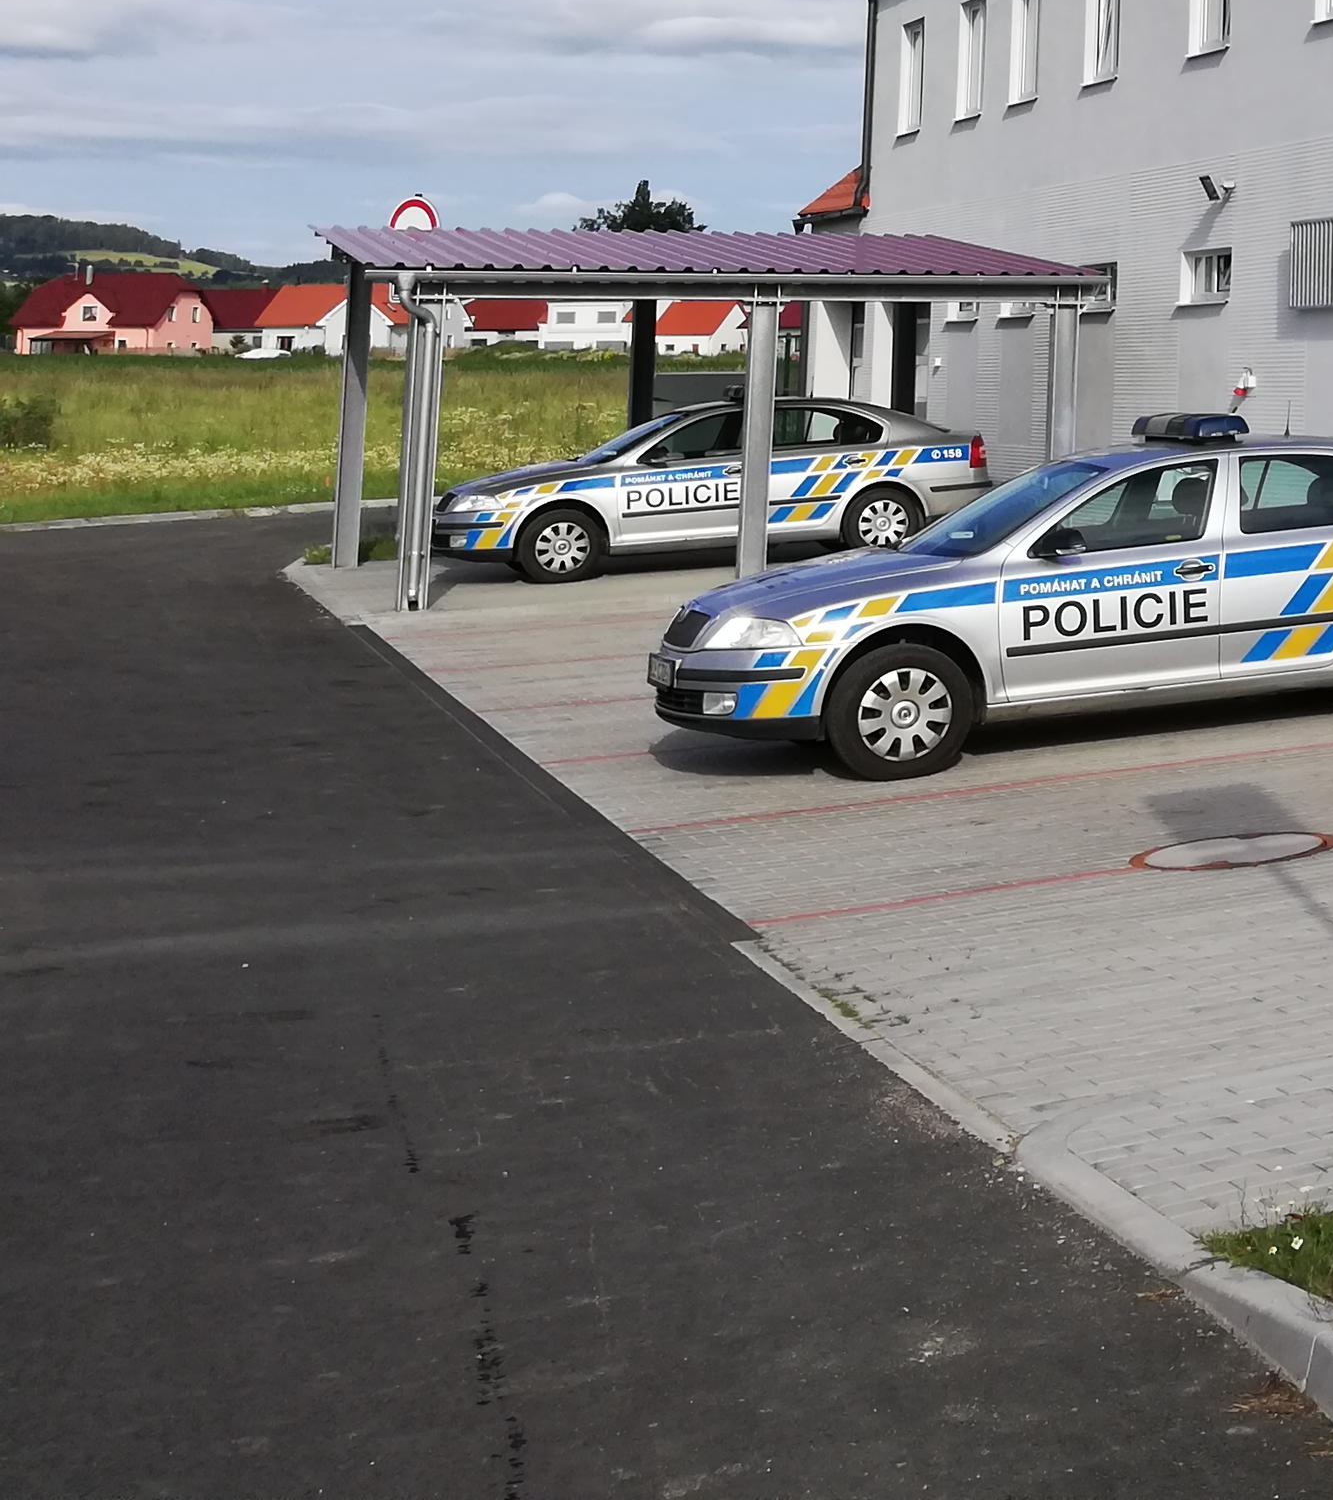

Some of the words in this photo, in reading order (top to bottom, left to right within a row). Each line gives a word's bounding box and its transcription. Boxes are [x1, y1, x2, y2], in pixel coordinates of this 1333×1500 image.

[942, 448, 963, 459] 158
[626, 481, 740, 510] POLICIE
[1020, 578, 1087, 595] POMÁHAT
[1090, 580, 1101, 589] A
[1104, 570, 1163, 588] CHRÁNIT
[1023, 588, 1208, 641] POLICIE
